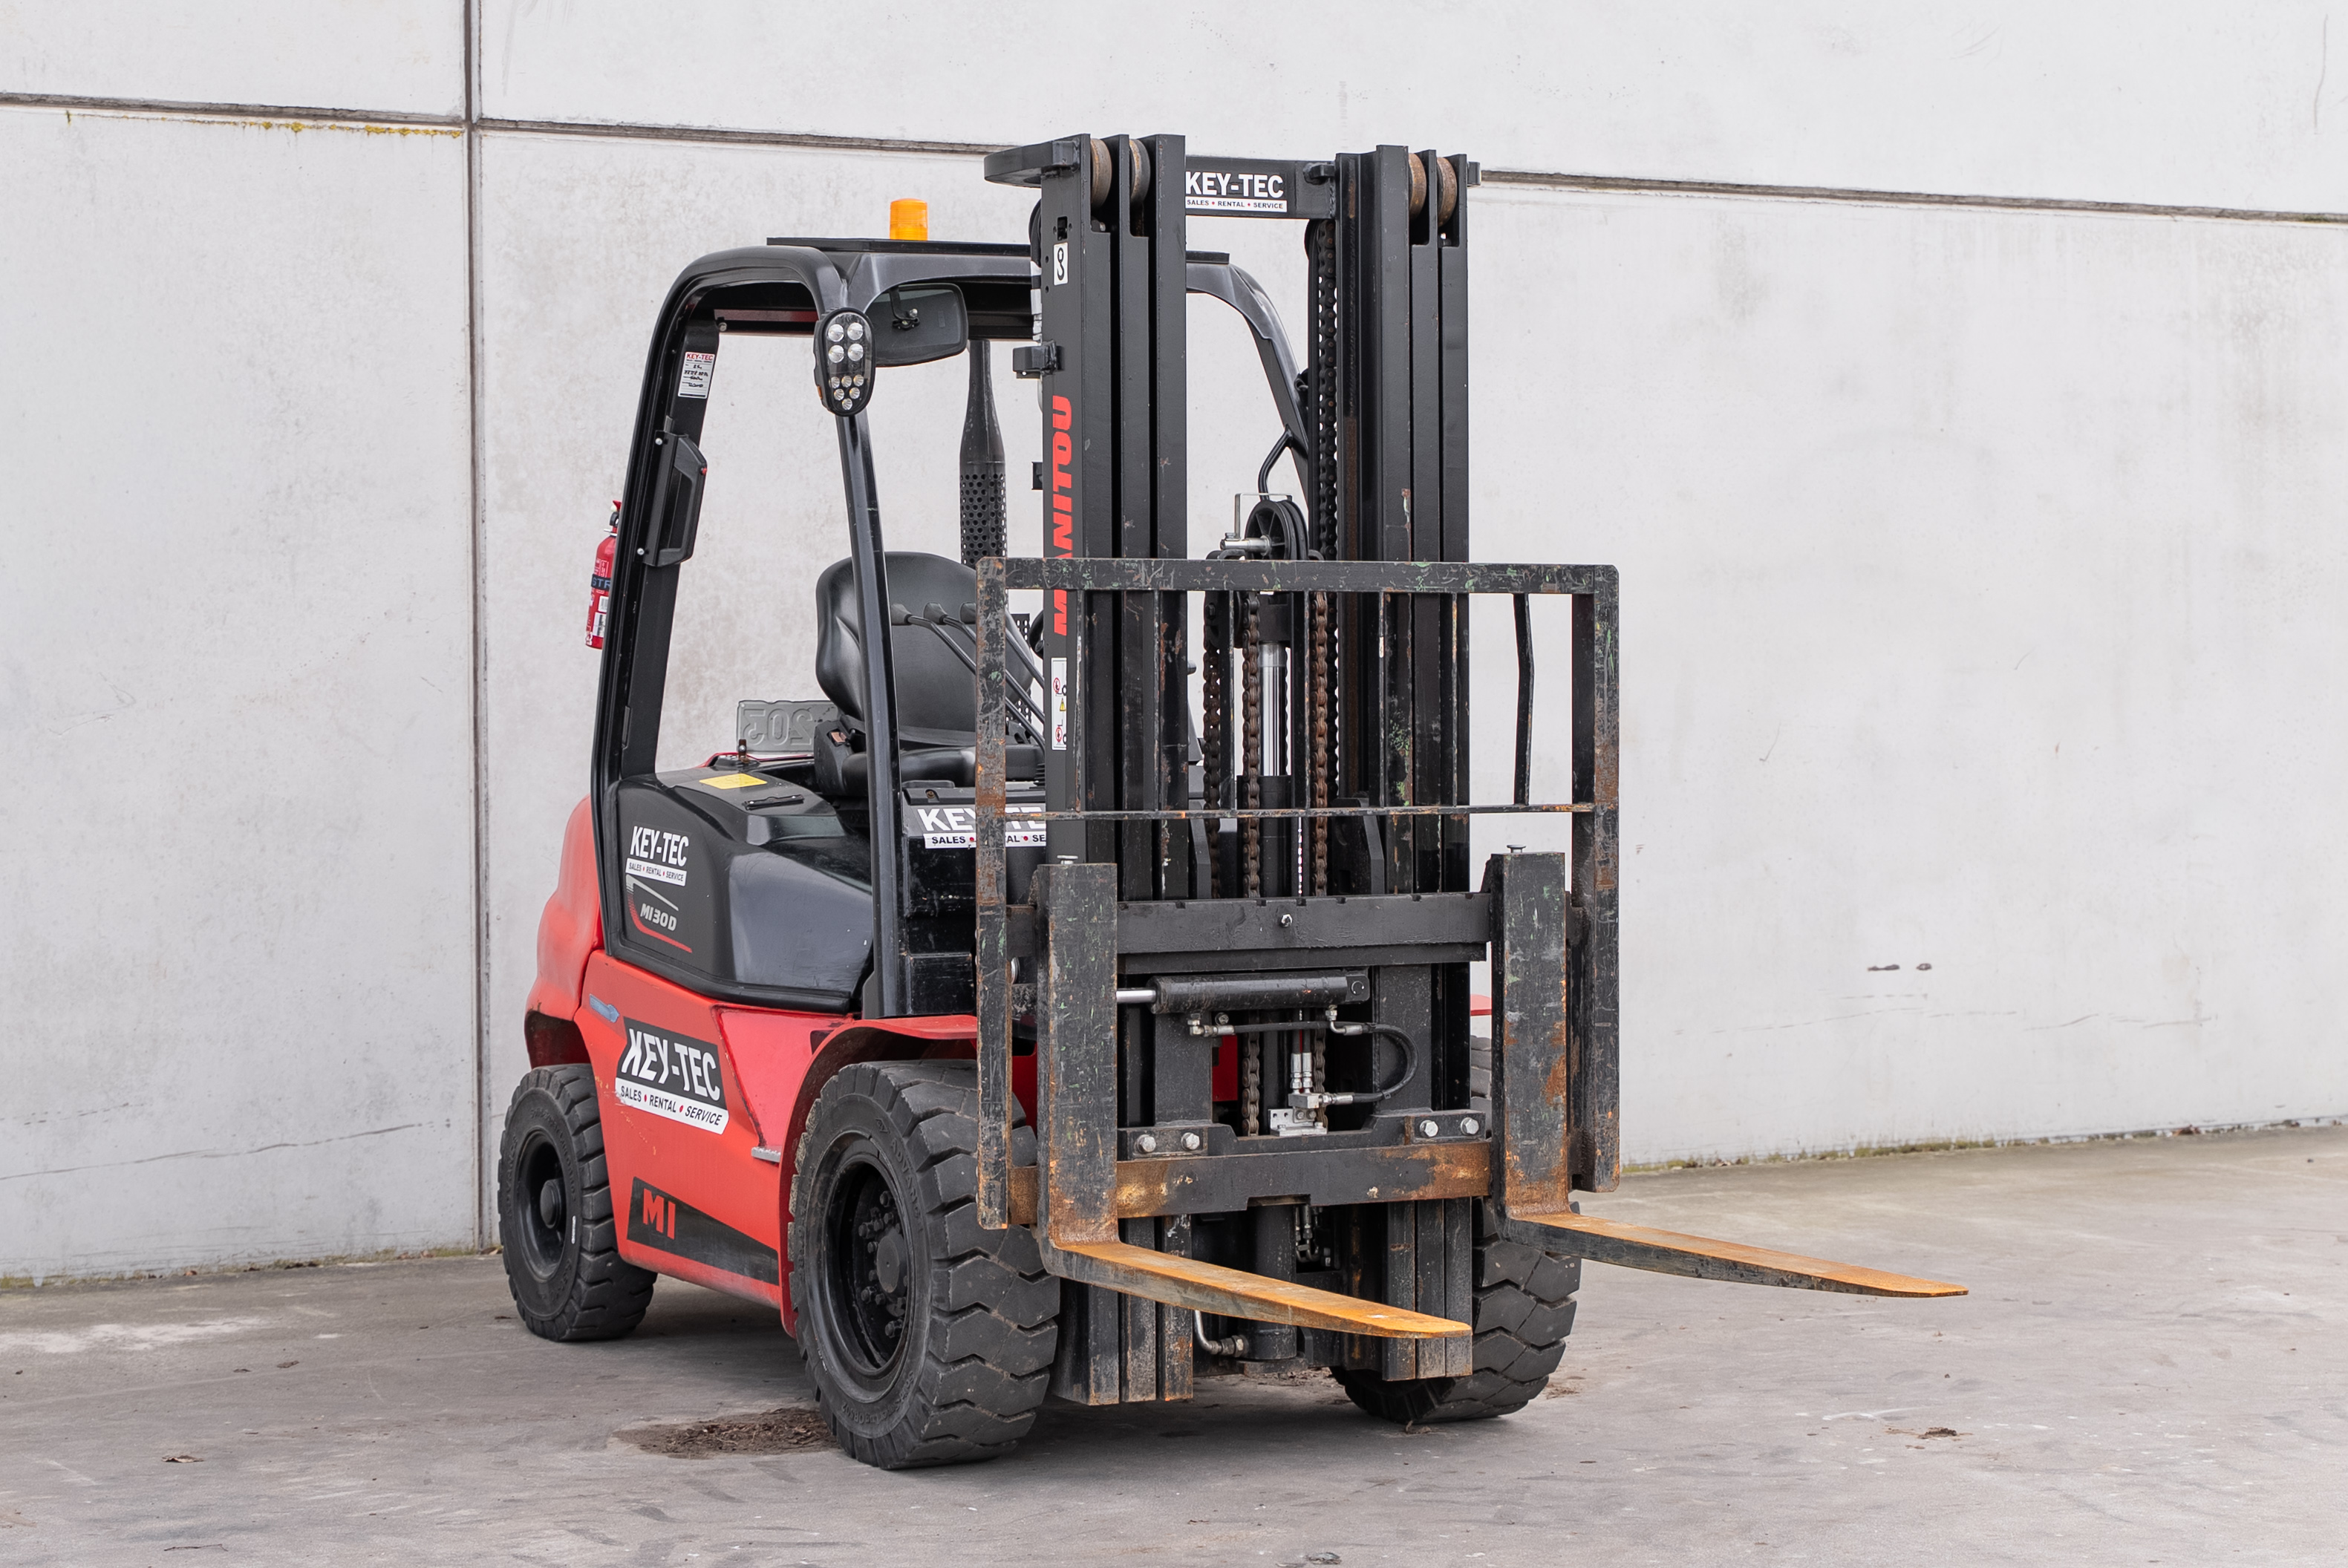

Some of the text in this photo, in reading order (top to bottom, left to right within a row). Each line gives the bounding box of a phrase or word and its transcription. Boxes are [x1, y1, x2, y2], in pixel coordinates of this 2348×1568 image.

[1185, 171, 1284, 198] KEY-TEC
[687, 353, 713, 361] KEY-TEC
[1052, 395, 1072, 636] MNITOU
[917, 806, 1046, 832] KETE
[630, 826, 689, 867] KEY-TEC
[931, 836, 966, 845] SALES
[628, 862, 684, 882] SALES RENTAL SERVICE
[621, 1028, 720, 1101] KEY-TEC
[621, 1085, 722, 1126] SALES RENTAL SERVICE
[642, 1188, 676, 1240] MI
